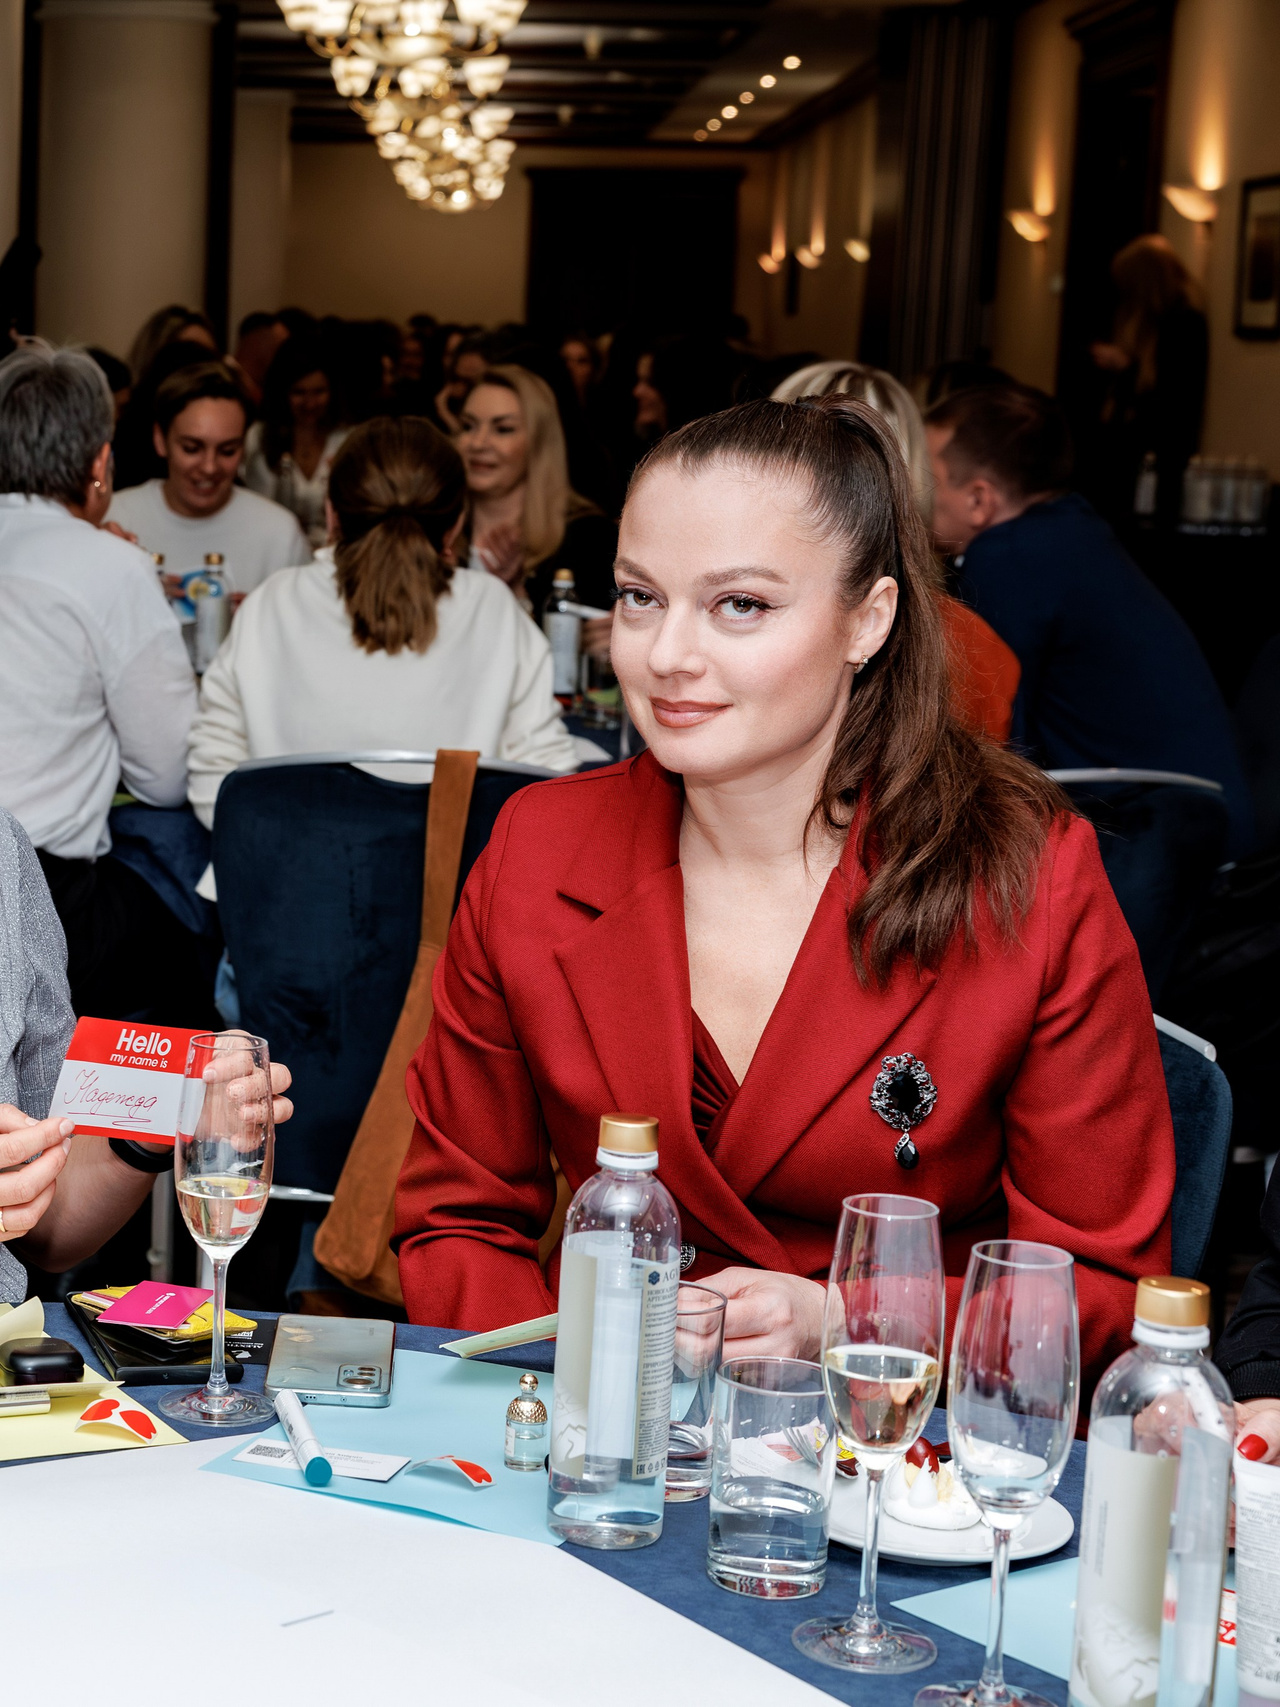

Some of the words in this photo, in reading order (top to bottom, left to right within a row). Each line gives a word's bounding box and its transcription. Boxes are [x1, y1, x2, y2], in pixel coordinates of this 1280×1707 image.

[116, 1028, 172, 1056] Hello
[110, 1053, 128, 1065] my
[128, 1056, 159, 1067] name
[160, 1058, 168, 1068] is
